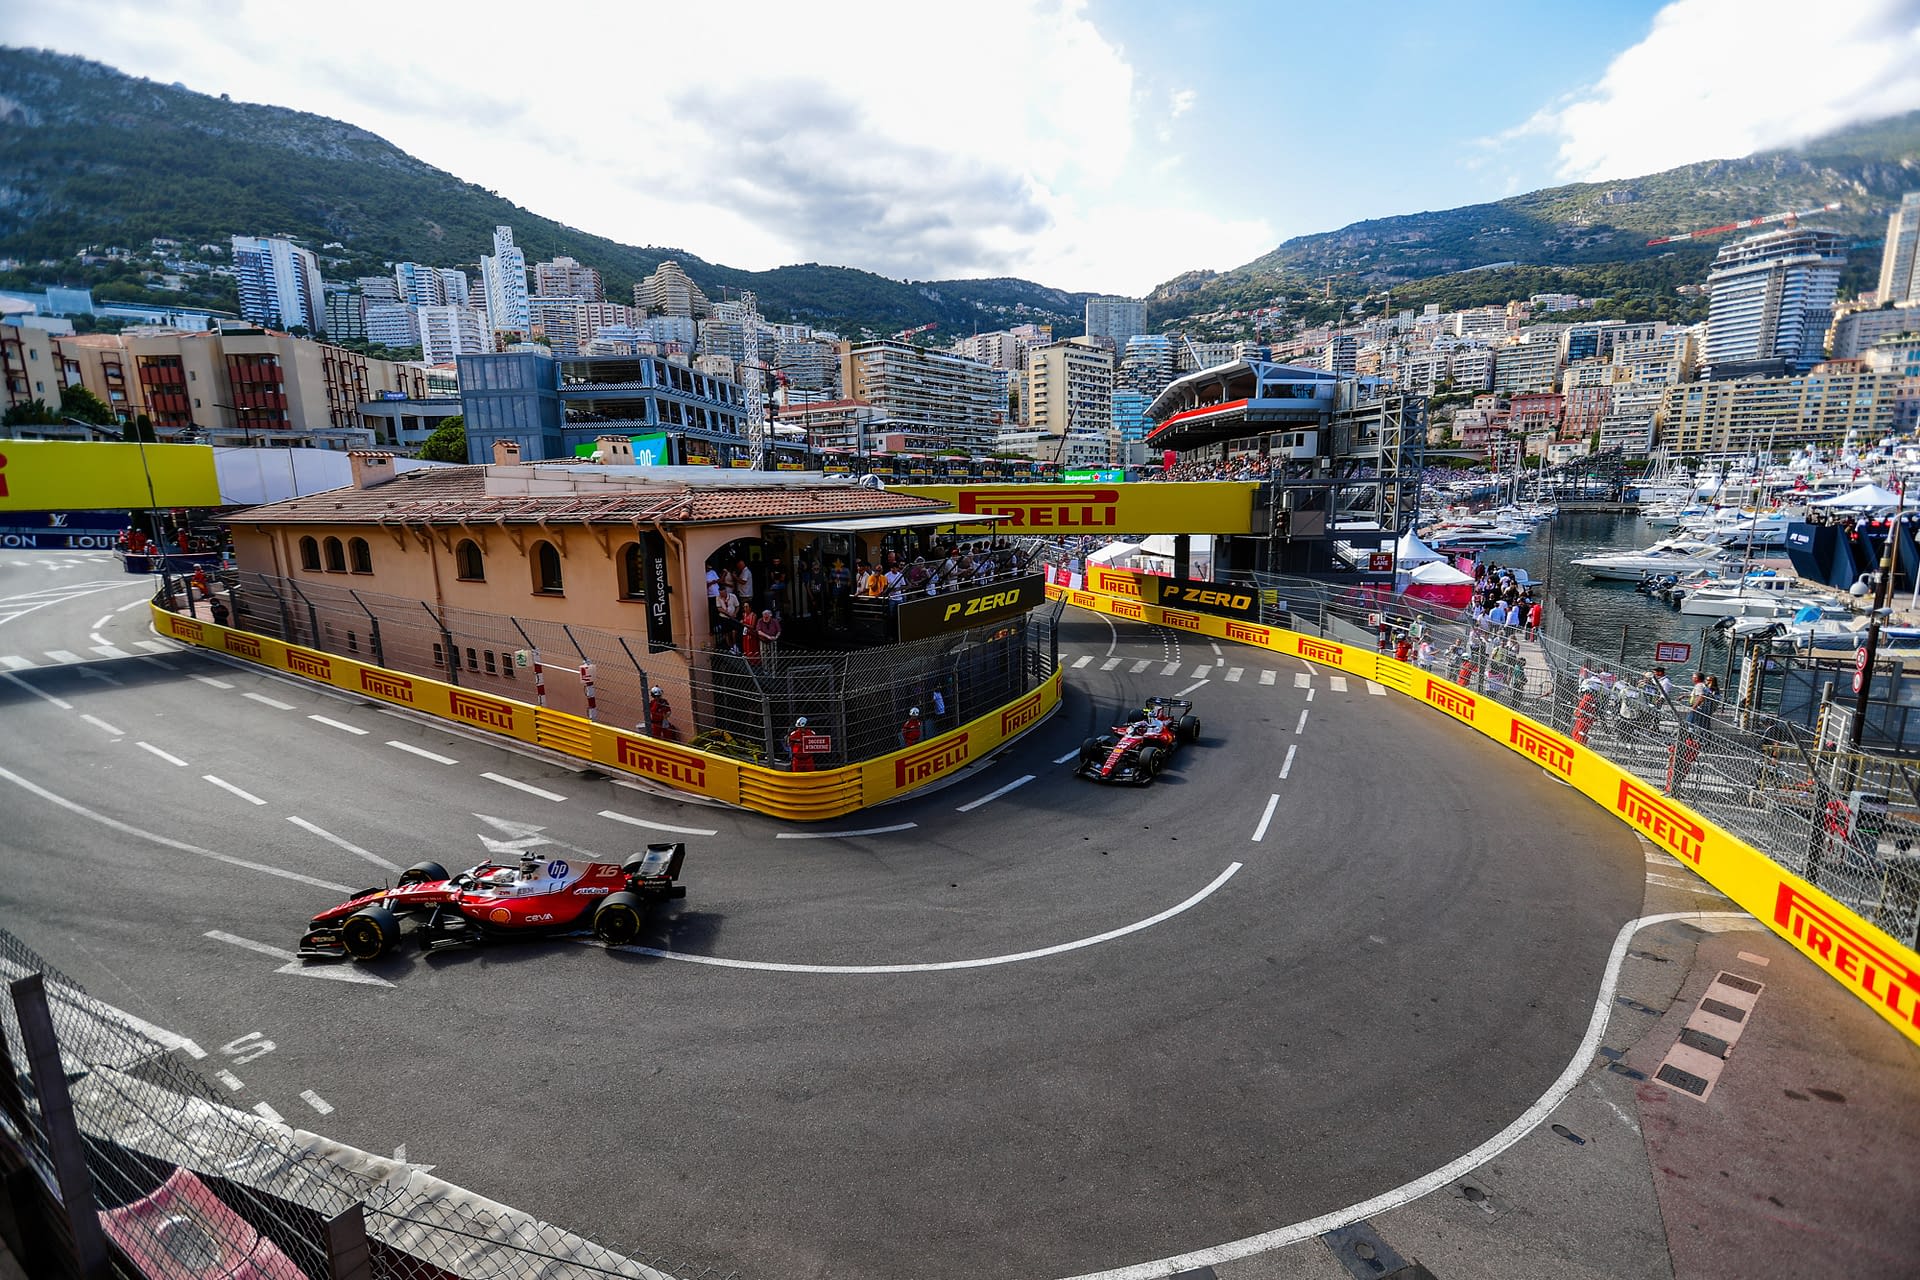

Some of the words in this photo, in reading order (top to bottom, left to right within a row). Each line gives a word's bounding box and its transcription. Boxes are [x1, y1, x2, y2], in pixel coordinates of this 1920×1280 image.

[653, 558, 667, 616] RASCASSE
[1074, 592, 1096, 607] PIRELLI
[1100, 572, 1142, 596] PIRELLI
[1163, 585, 1179, 597] P
[1183, 588, 1252, 610] ZERO
[944, 603, 961, 621] P
[965, 589, 1020, 616] ZERO
[1112, 600, 1142, 618] PIRELLI
[1162, 610, 1200, 630] PIRELLI
[171, 617, 204, 641] PIRELLI
[1226, 621, 1270, 645] PIRELLI
[224, 632, 262, 659] PIRELLI
[1298, 637, 1343, 665] PIRELLI
[286, 649, 332, 680] PIRELLI
[360, 668, 414, 702] PIRELLI
[1426, 679, 1476, 721] PIRELLI
[449, 691, 514, 730] PIRELLI
[1001, 693, 1042, 737] PIRELLI
[617, 736, 706, 788] PIRELLI
[895, 732, 969, 789] PIRELLI
[1509, 718, 1575, 776] PIRELLI
[1617, 778, 1705, 865] PIRELLI
[551, 860, 566, 879] hp
[596, 865, 619, 877] 16
[1774, 881, 1920, 1030] PIRELLI
